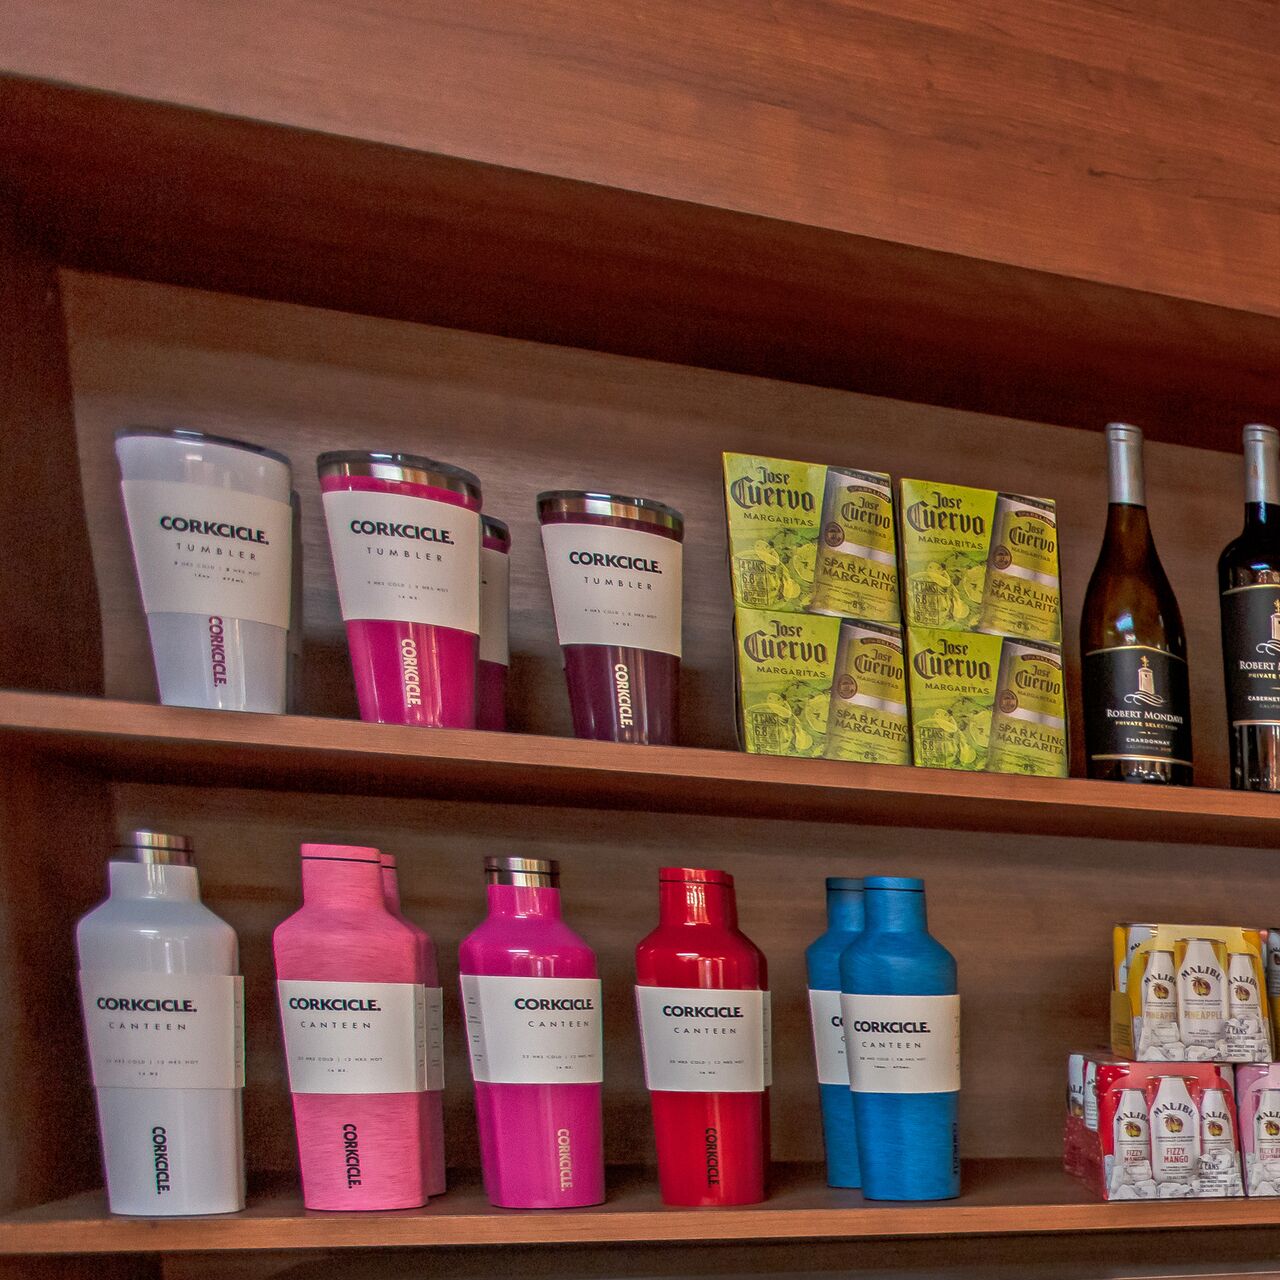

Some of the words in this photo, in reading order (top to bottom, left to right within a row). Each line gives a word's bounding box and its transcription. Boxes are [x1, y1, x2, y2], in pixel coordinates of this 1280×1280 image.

[758, 466, 789, 485] Jose
[731, 477, 814, 511] Cuervo
[932, 492, 962, 509] Jose
[743, 512, 814, 527] MARGARITAS
[906, 500, 985, 536] Cuervo
[160, 515, 270, 545] CORKCICLE.
[350, 519, 454, 545] CORKCICLE.
[176, 541, 256, 560] TUMBLER
[918, 536, 983, 550] MARGARITAS
[366, 546, 443, 562] TUMBLER
[569, 551, 663, 574] CORKCICLE.
[824, 557, 897, 583] SPARKLING
[584, 576, 653, 591] TUMBLER
[771, 621, 802, 638] Jose
[209, 615, 227, 687] CORKCICLE.
[744, 631, 828, 664] Cuervo
[939, 639, 968, 656] Jose
[401, 638, 421, 707] CORKCICLE.
[913, 650, 991, 680] Cuervo
[1239, 660, 1275, 671] ROBERT
[614, 662, 633, 728] CORKCICLE.
[1107, 708, 1141, 719] ROBERT
[1144, 712, 1183, 724] MONDAVI
[1145, 723, 1177, 731] SELECTION
[1126, 737, 1170, 745] CHARDONNAY
[1181, 964, 1222, 980] MALIBU
[97, 997, 198, 1012] CORKCICLE.
[289, 998, 381, 1011] CORKCICLE.
[514, 997, 594, 1012] CORKCICLE.
[663, 1005, 744, 1018] CORKCICLE.
[527, 1019, 590, 1028] CANTEEN
[1185, 1011, 1223, 1020] PINEAPPLE
[108, 1022, 186, 1031] CANTEEN
[300, 1021, 371, 1029] CANTEEN
[854, 1020, 931, 1033] CORKCICLE.
[861, 1041, 921, 1049] CANTEEN
[1153, 1101, 1196, 1119] MALIBU
[343, 1124, 362, 1189] CORKCICLE.
[705, 1128, 720, 1187] CORKCICLE.
[1166, 1147, 1185, 1155] FIZZY
[152, 1126, 170, 1195] CORKCICLE.
[556, 1128, 571, 1192] CORKCICLE.
[1164, 1155, 1188, 1164] MANGO
